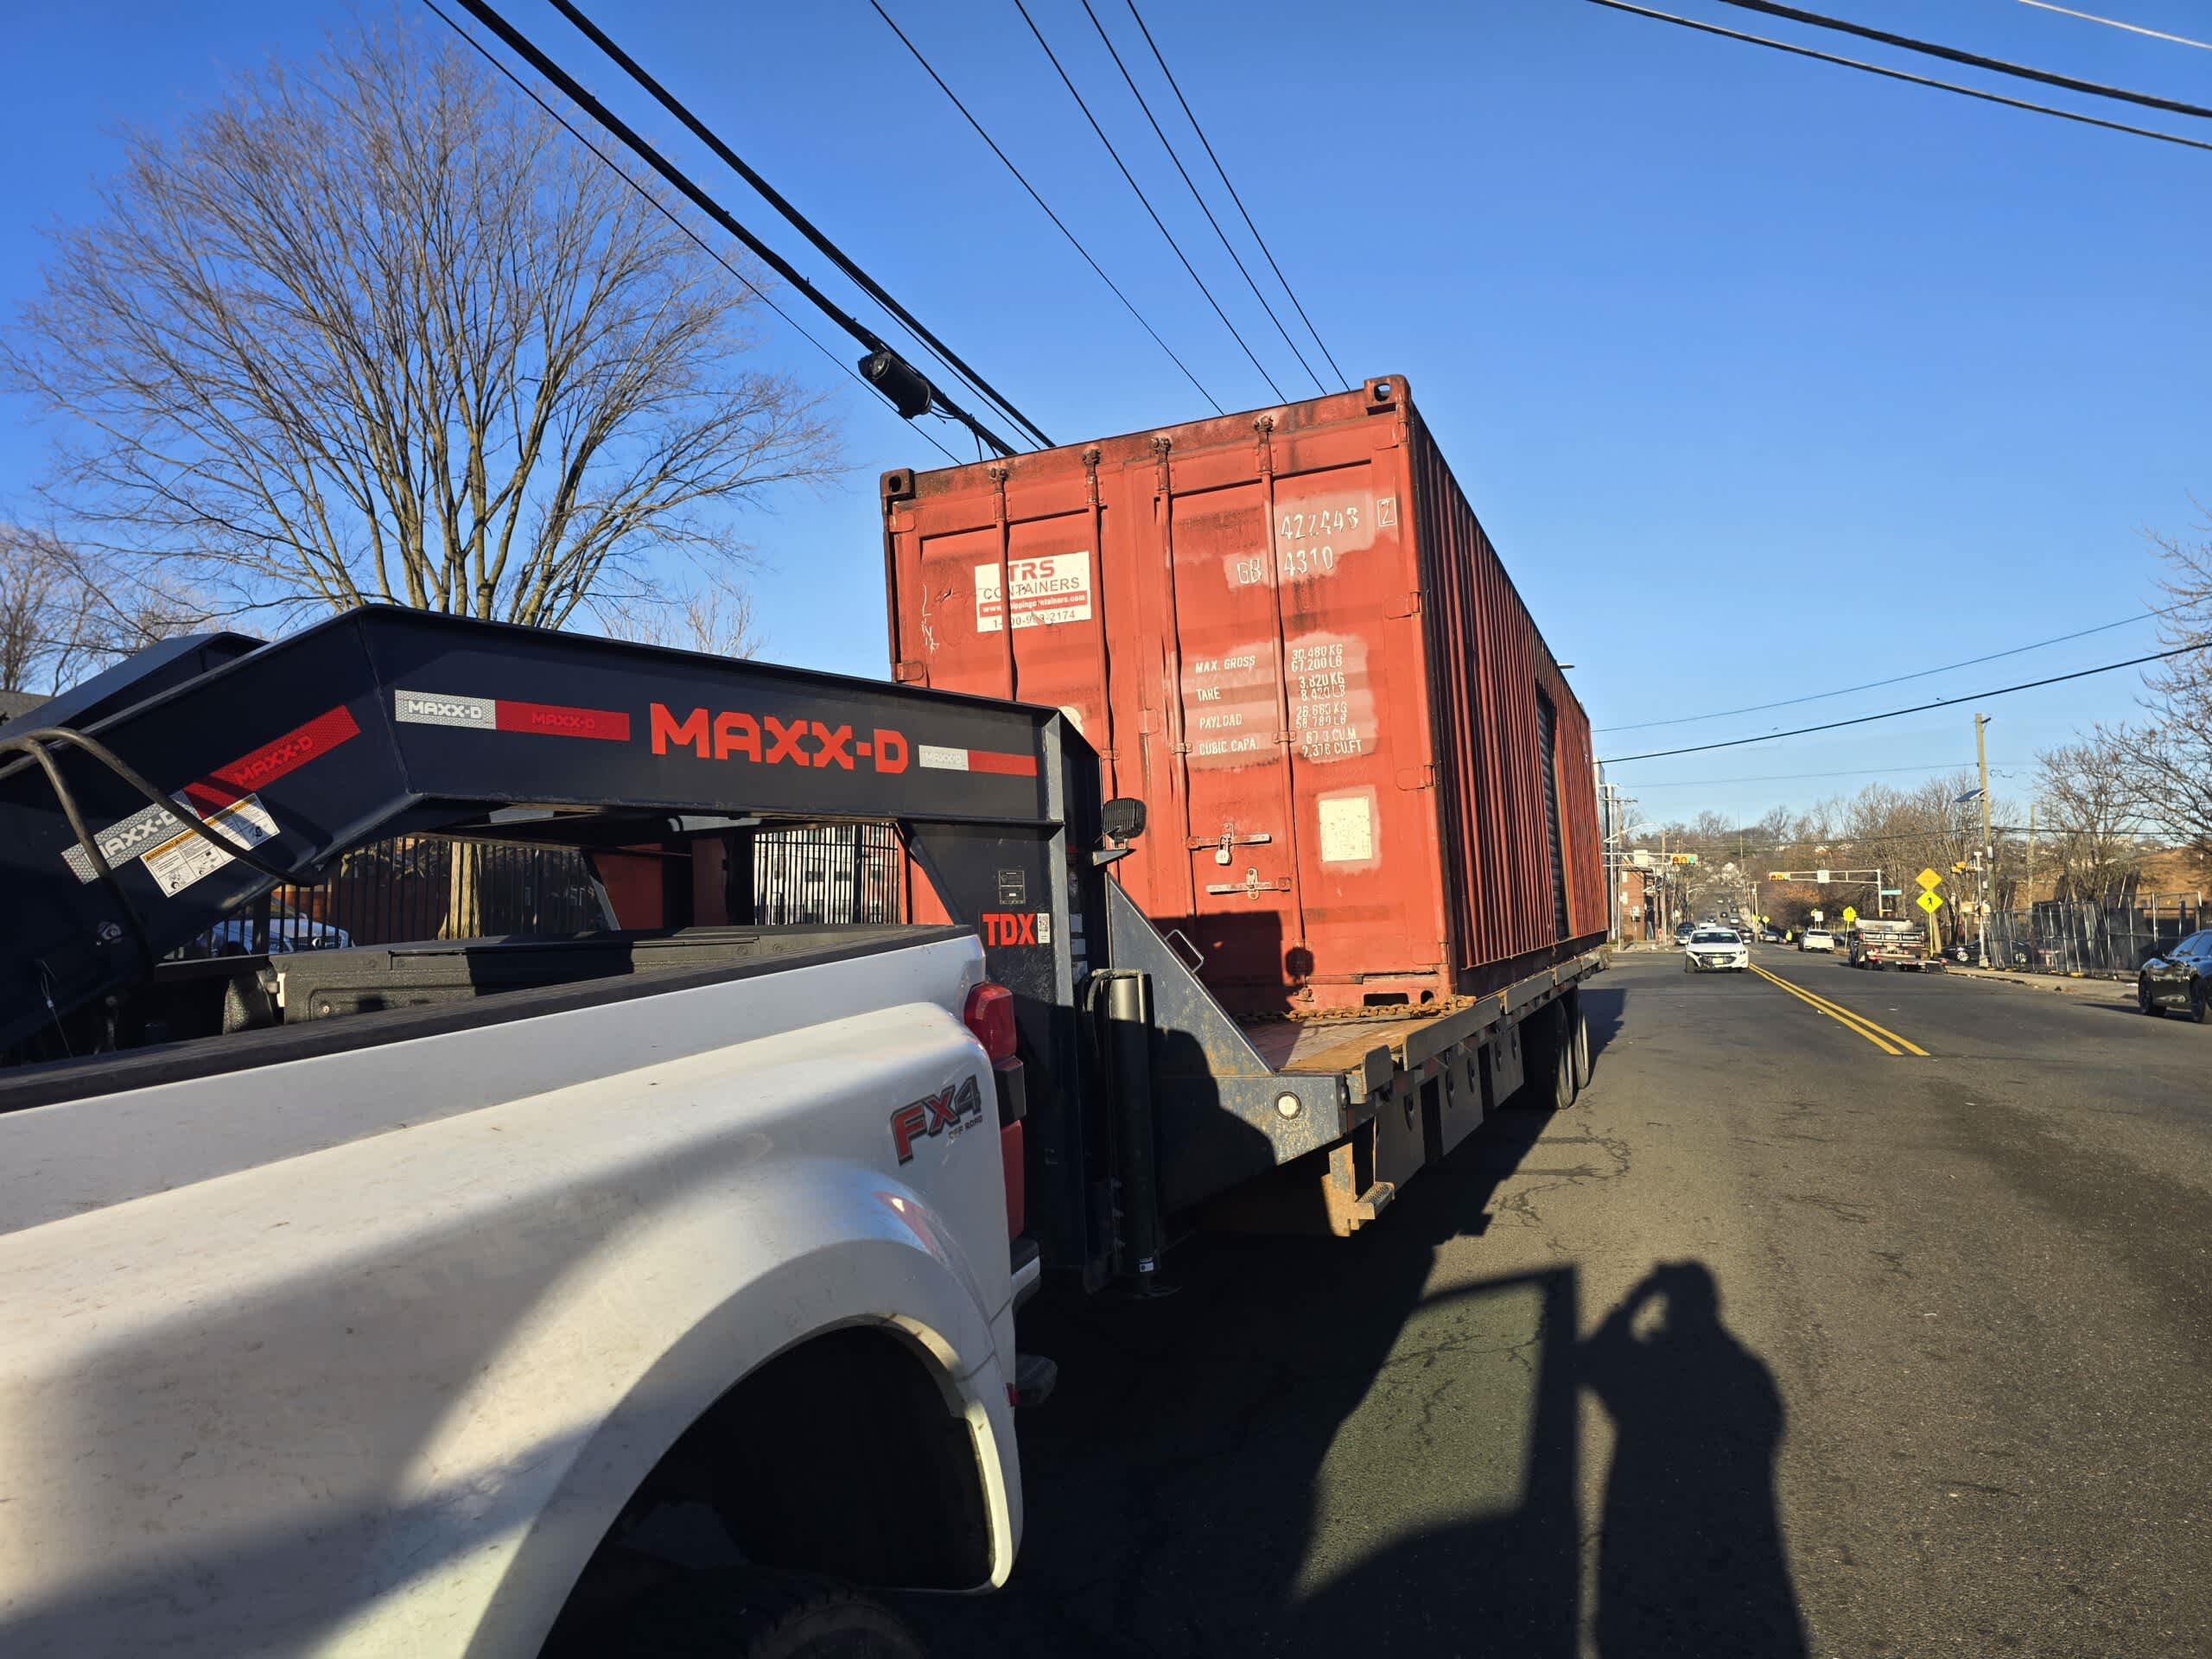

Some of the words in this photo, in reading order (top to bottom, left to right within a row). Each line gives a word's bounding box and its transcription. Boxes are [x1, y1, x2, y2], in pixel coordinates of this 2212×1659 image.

[1007, 560, 1055, 582] TRS
[1236, 558, 1262, 584] GB
[1283, 545, 1333, 576] 4310
[983, 576, 1079, 600] CONTAINERS
[1291, 645, 1327, 660] 30.480
[1329, 643, 1343, 656] KG
[1224, 655, 1256, 671] GROSS
[1291, 657, 1327, 672] 67.200
[1329, 655, 1342, 668] LB
[1298, 673, 1329, 689] 3.820
[1331, 671, 1344, 685] KG
[1195, 686, 1222, 702] TARE
[1300, 686, 1331, 702] 8420
[1332, 684, 1345, 698] LB
[407, 700, 483, 720] MAXX-D
[1333, 701, 1348, 715] KG
[531, 711, 596, 729] MAXX-D
[1199, 713, 1243, 729] PAYLOAD
[1333, 713, 1347, 726] LB
[650, 702, 909, 774] MAXX-D
[1198, 740, 1228, 756] CUBIC
[1230, 737, 1259, 753] CAPA.
[233, 735, 314, 786] MAXX-D
[925, 751, 963, 766] MAXX-D
[982, 912, 1036, 946] TDX
[890, 1073, 982, 1166] FX4
